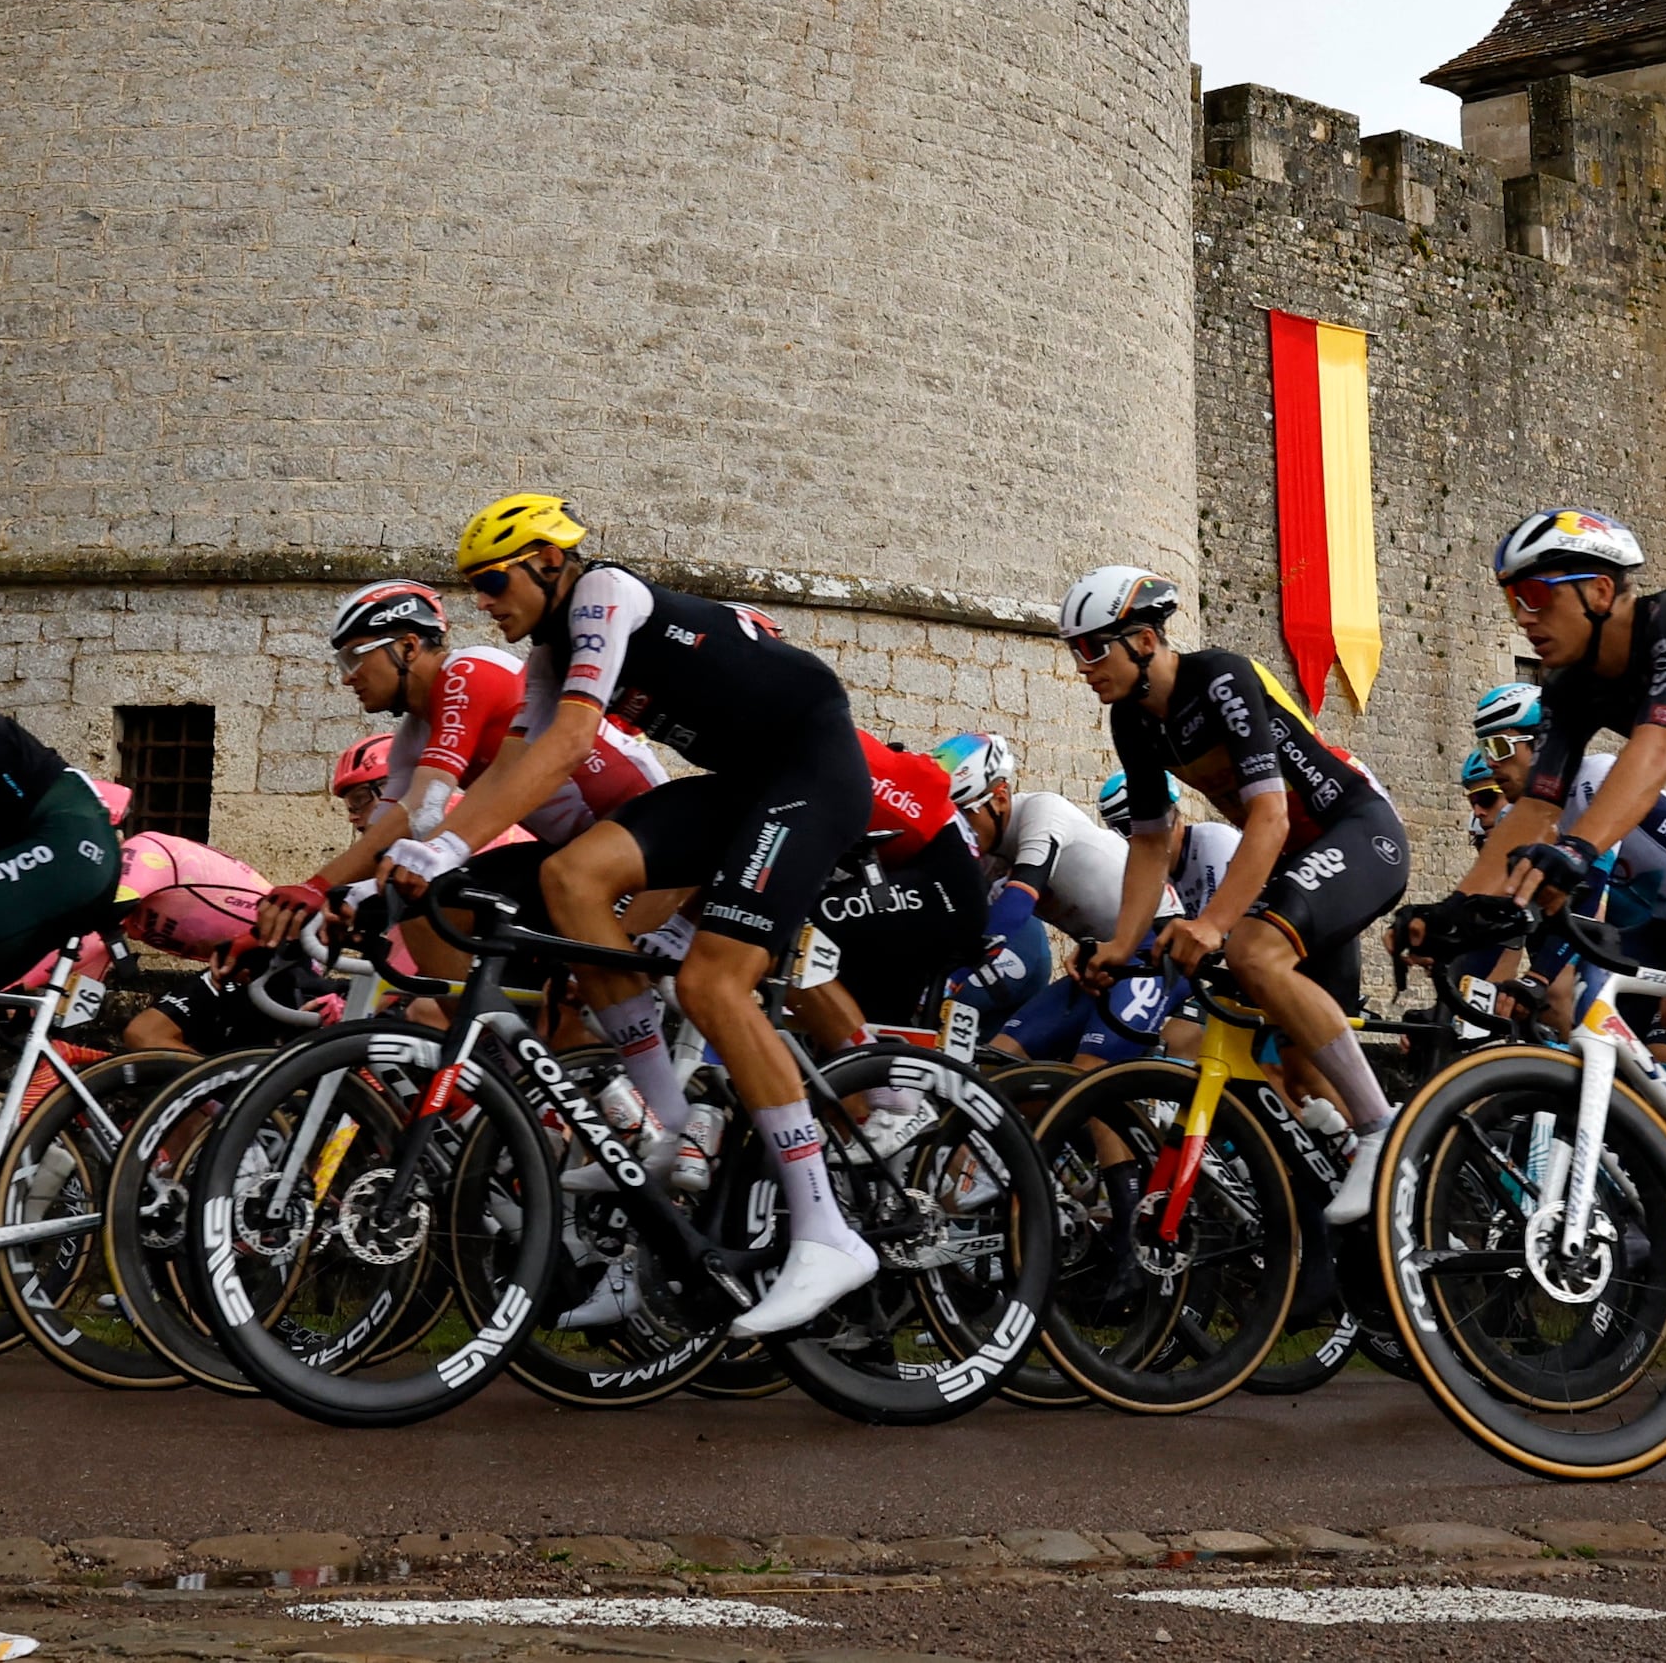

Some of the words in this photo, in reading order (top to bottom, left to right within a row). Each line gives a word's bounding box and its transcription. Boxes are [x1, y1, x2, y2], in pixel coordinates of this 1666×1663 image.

[368, 597, 420, 626] ekoi
[664, 623, 696, 646] FAB
[438, 659, 475, 749] Cofidis
[1281, 740, 1324, 786] SOLAR
[737, 819, 781, 891] #WeAreUAE.
[702, 900, 775, 933] Emirates
[819, 882, 925, 922] Cofdis
[811, 945, 837, 973] 14
[72, 988, 102, 1019] 26
[612, 1018, 655, 1047] UAE
[949, 1012, 974, 1055] 143
[430, 1068, 456, 1108] Emirates
[517, 1037, 646, 1187] COLNAGO
[773, 1124, 818, 1150] UAE
[958, 1237, 1002, 1254] 795
